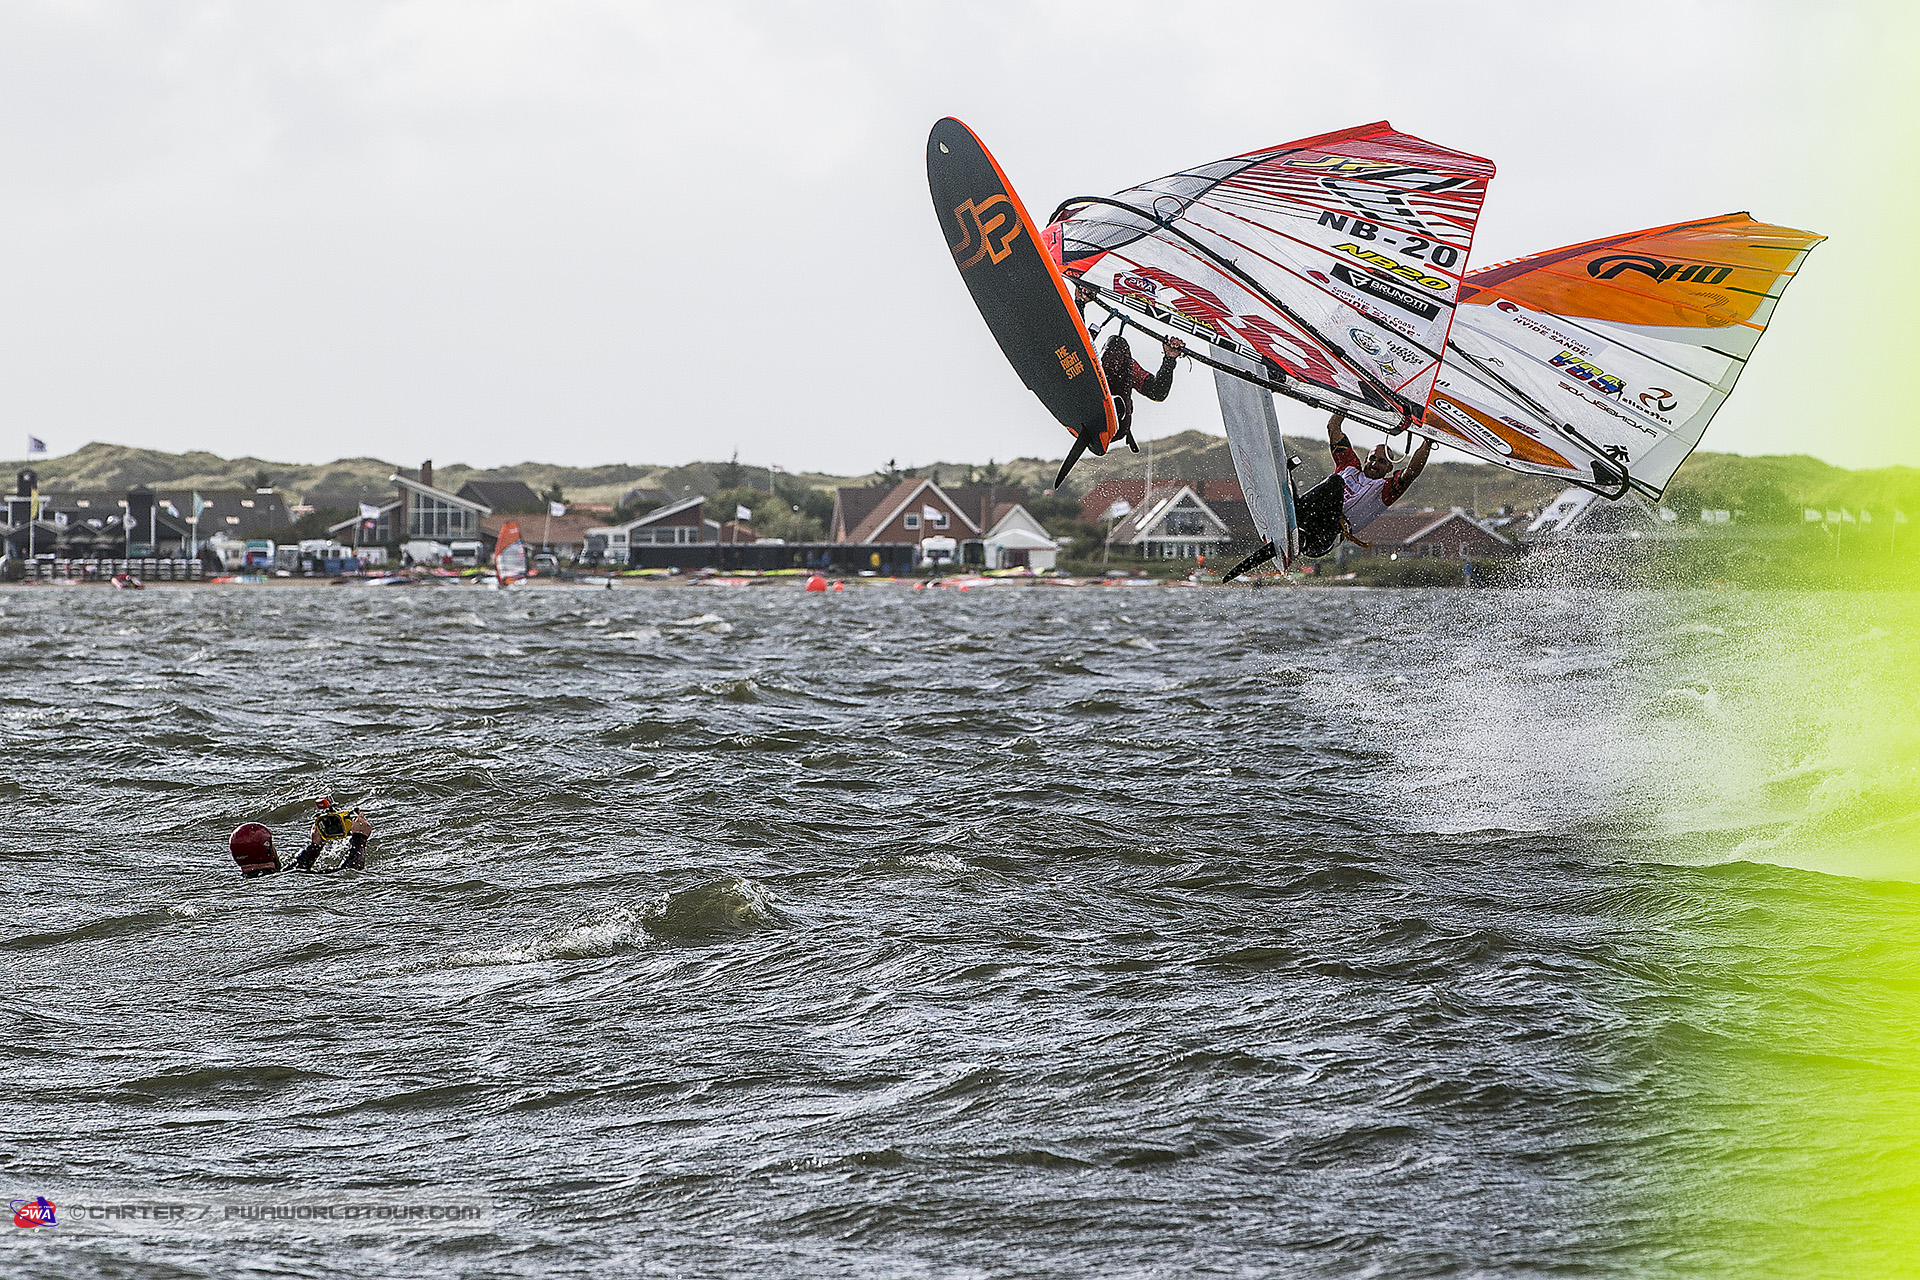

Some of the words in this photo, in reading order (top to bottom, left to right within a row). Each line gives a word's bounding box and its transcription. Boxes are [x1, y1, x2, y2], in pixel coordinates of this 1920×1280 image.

[953, 194, 1024, 272] JP
[1317, 210, 1459, 269] NB-20
[1331, 242, 1453, 291] NB20
[1370, 280, 1429, 312] BRUNOTTI
[1393, 317, 1416, 331] Coast
[1054, 345, 1070, 361] THE
[1060, 351, 1080, 370] RIGHT
[1065, 360, 1085, 380] STUFF
